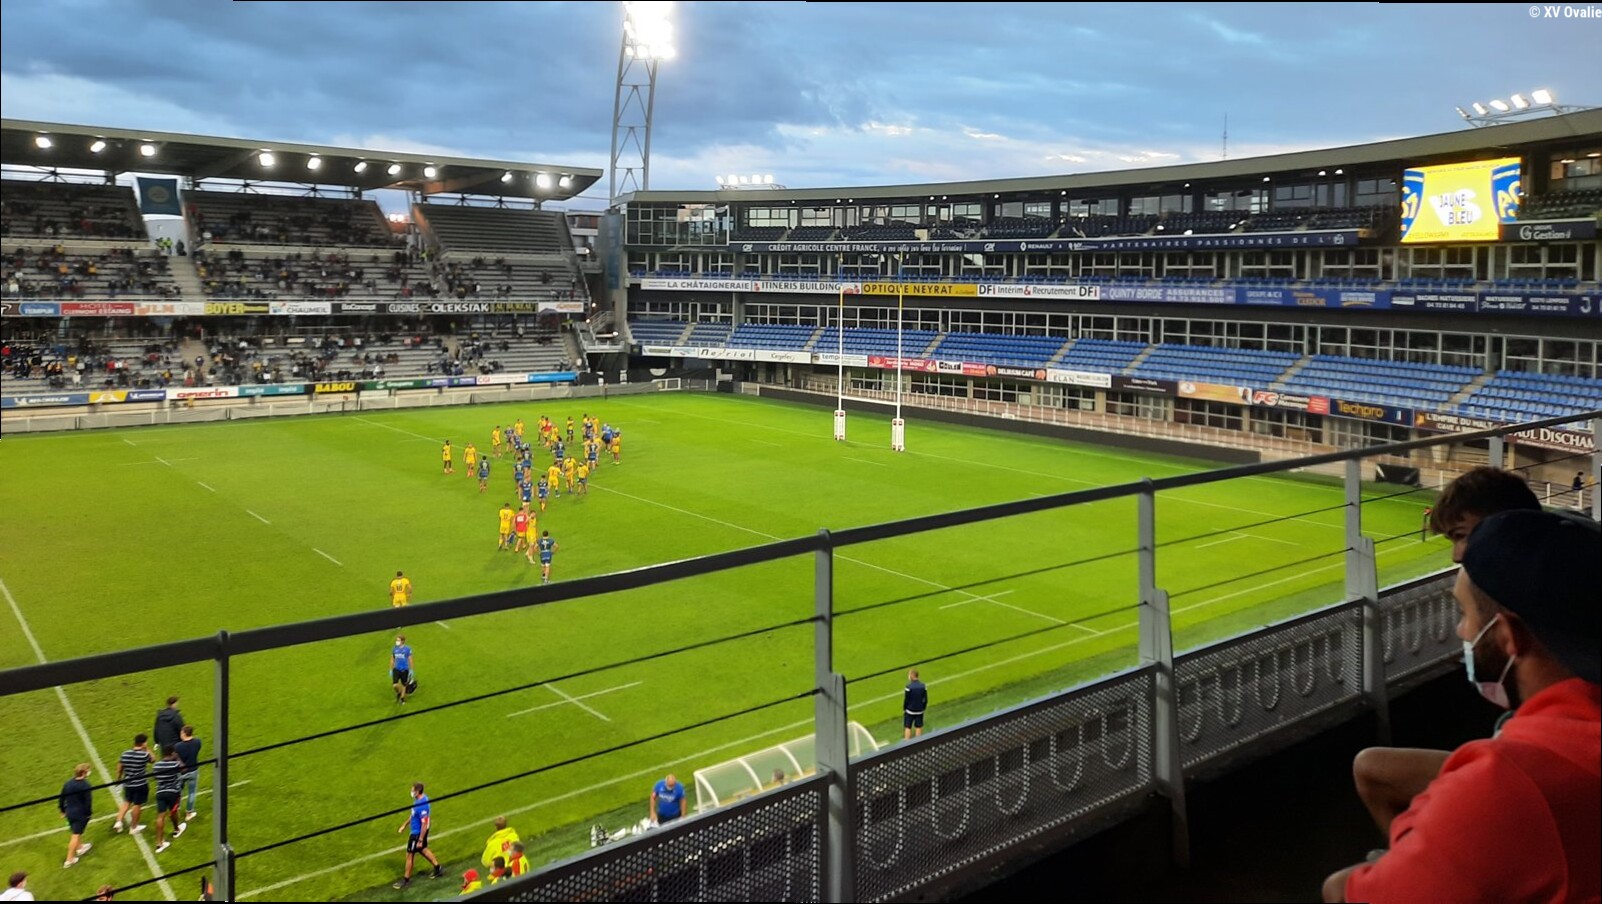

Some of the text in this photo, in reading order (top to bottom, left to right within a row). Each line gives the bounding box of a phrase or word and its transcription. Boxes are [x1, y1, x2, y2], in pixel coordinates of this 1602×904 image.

[1440, 193, 1466, 208] JAUNE
[1449, 210, 1474, 225] BLEU
[768, 244, 791, 252] CRÉDIT
[793, 244, 824, 252] AGRICOLE
[825, 244, 851, 252] CENTRE
[667, 281, 679, 289] LA
[680, 281, 750, 290] CHÂTAIGNERAIE
[761, 281, 841, 292] ITINERIS BUILDING
[863, 284, 909, 294] OPTIQUE
[913, 285, 953, 295] NEYRAT
[997, 286, 1024, 294] Intérim
[1024, 285, 1032, 296] &
[1032, 286, 1077, 296] Recrutement
[1167, 288, 1225, 296] ASSURANCES
[205, 302, 244, 314] BOYER
[431, 303, 489, 313] OLEKSIAK
[477, 377, 491, 385] CGI
[315, 382, 355, 393] BABOU
[1459, 418, 1472, 426] DU
